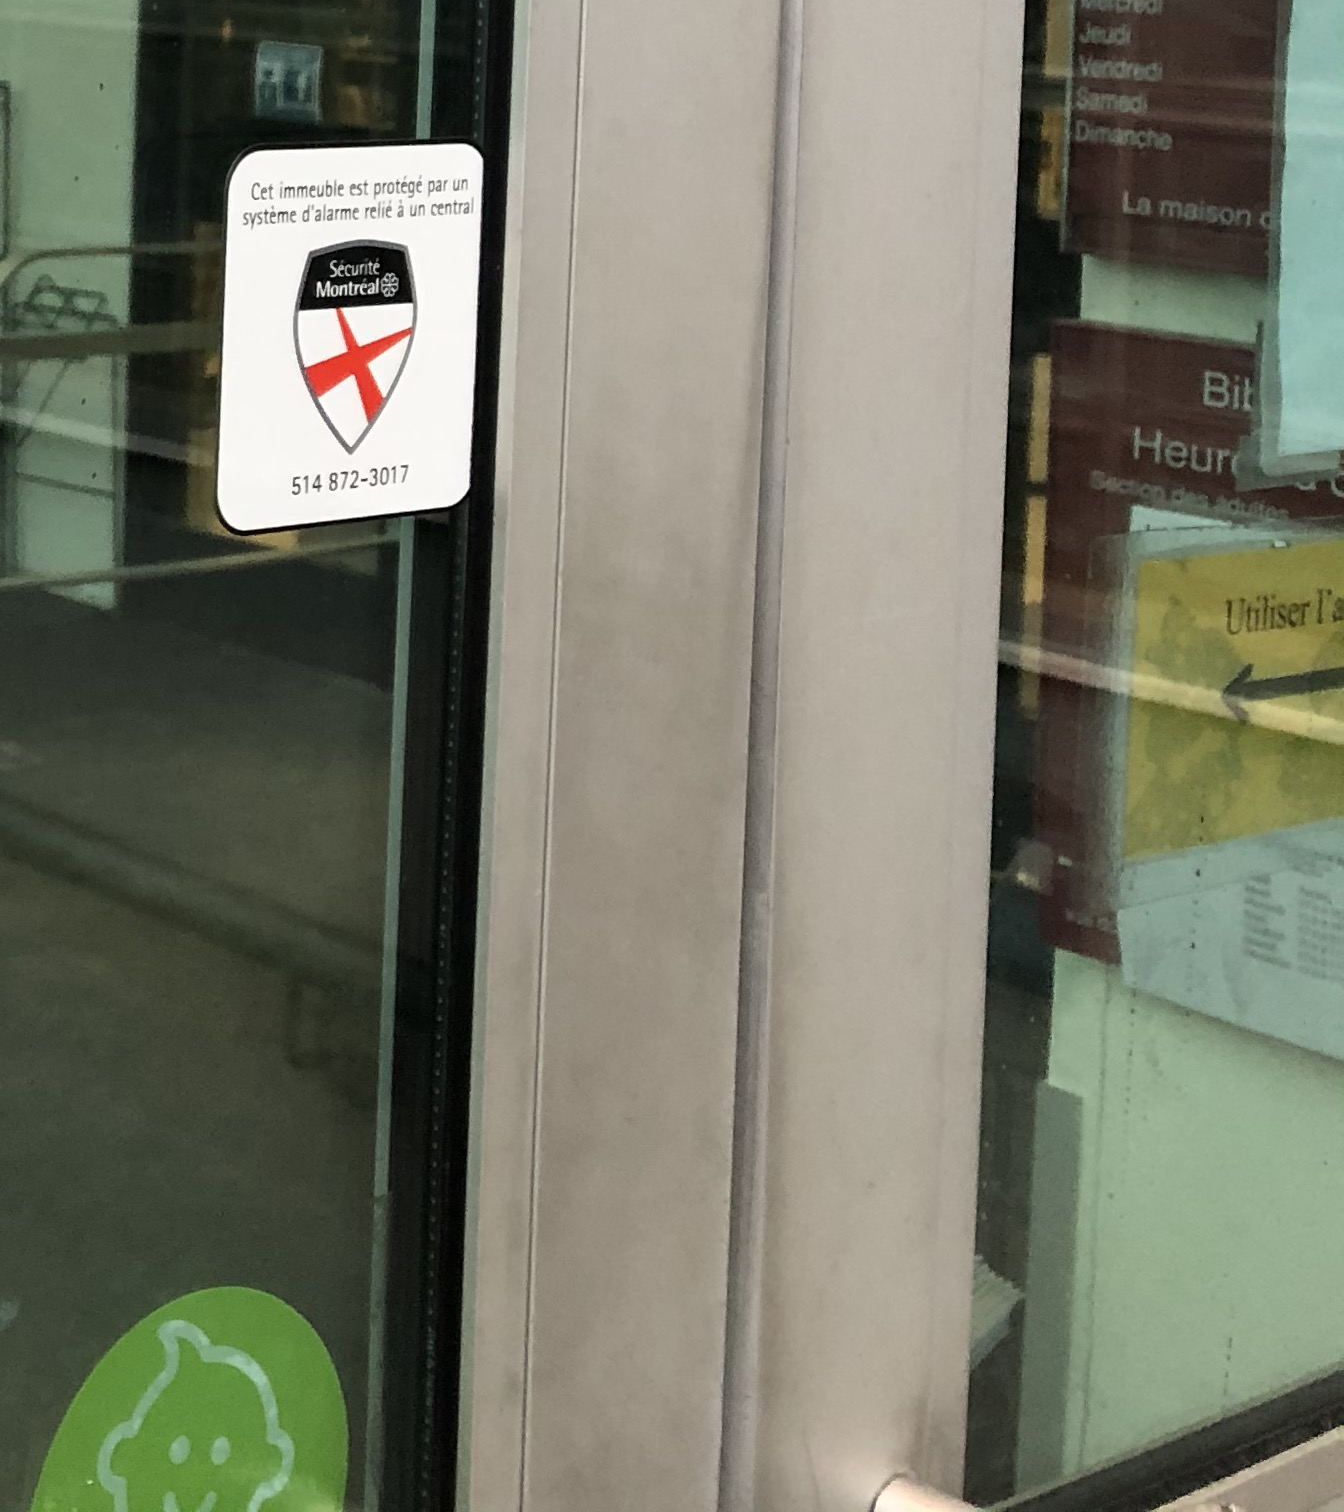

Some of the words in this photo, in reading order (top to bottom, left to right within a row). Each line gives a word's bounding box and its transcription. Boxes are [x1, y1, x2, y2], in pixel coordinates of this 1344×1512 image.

[251, 181, 274, 201] Cet
[279, 179, 345, 200] immeuble
[349, 180, 369, 197] est
[373, 175, 423, 201] protégé
[427, 177, 448, 197] par
[452, 177, 469, 191] un
[242, 205, 297, 230] système
[302, 202, 360, 223] d'alarme
[365, 200, 392, 220] relié
[397, 199, 405, 218] à
[409, 203, 426, 217] un
[430, 197, 475, 216] central
[1122, 190, 1151, 216] La
[1159, 199, 1252, 228] maison
[329, 258, 381, 279] Sécurité
[315, 278, 380, 299] Montréal
[1131, 426, 1239, 476] Heur
[291, 476, 322, 496] 514
[328, 464, 409, 493] 872-3017
[1226, 592, 1312, 636] Utiliser
